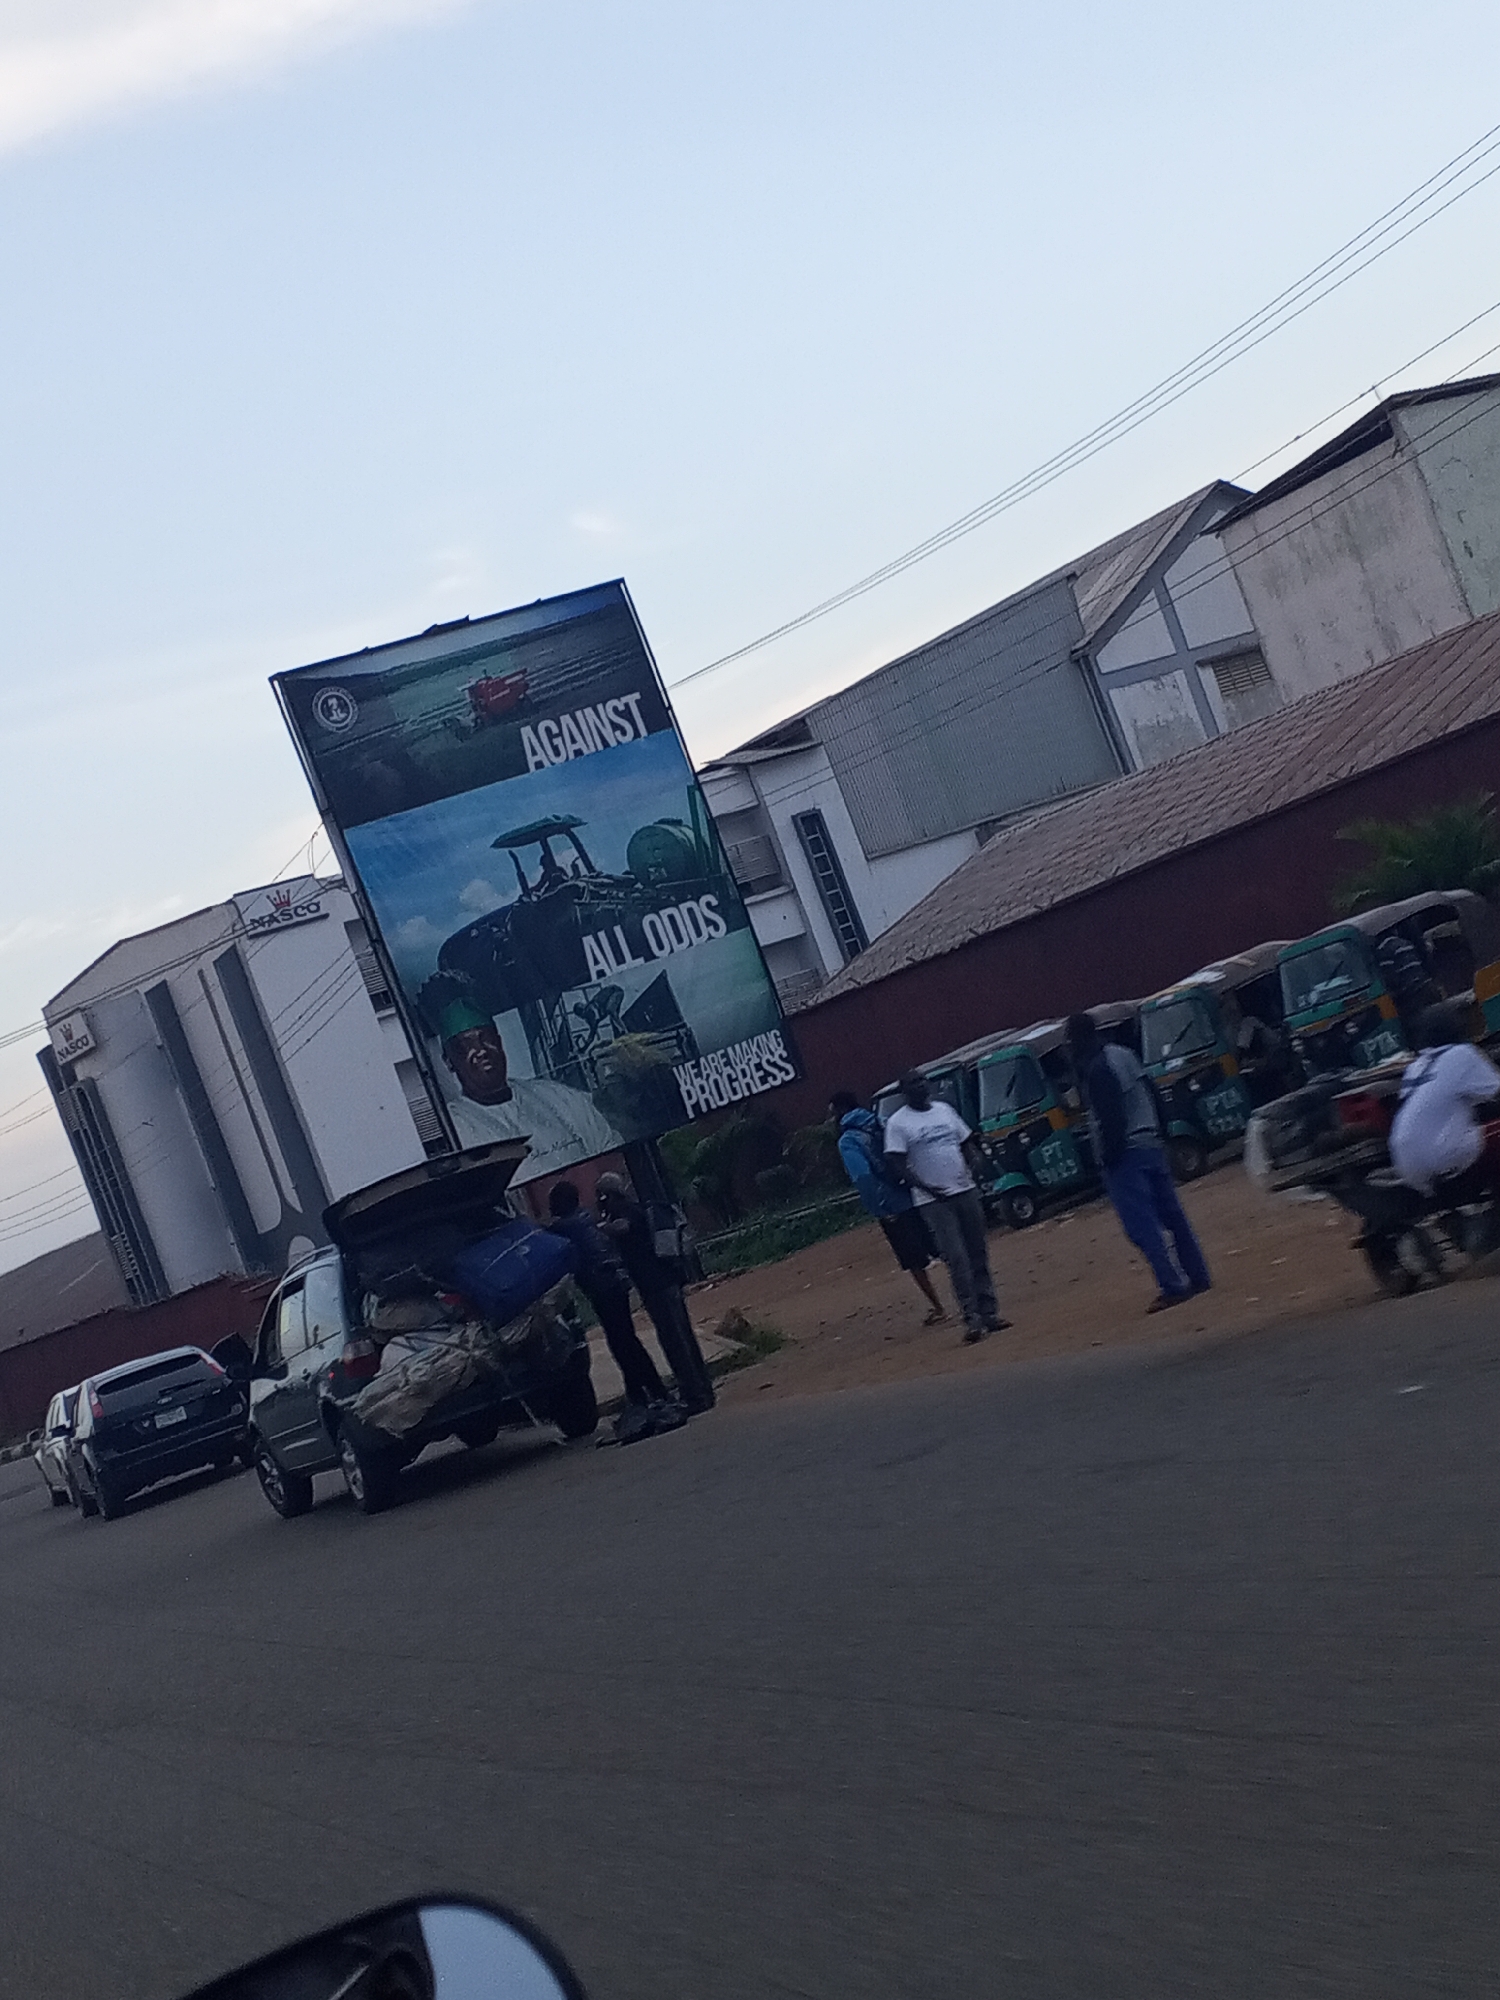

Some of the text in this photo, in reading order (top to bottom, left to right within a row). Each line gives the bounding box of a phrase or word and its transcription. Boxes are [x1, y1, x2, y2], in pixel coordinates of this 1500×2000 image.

[520, 692, 648, 773] AGAINST
[249, 900, 322, 929] NASCO
[581, 893, 728, 981] ALL ODDS
[57, 1033, 90, 1062] NASCO
[672, 1029, 784, 1087] WE ARE MAKING
[680, 1050, 796, 1119] PROGRESS
